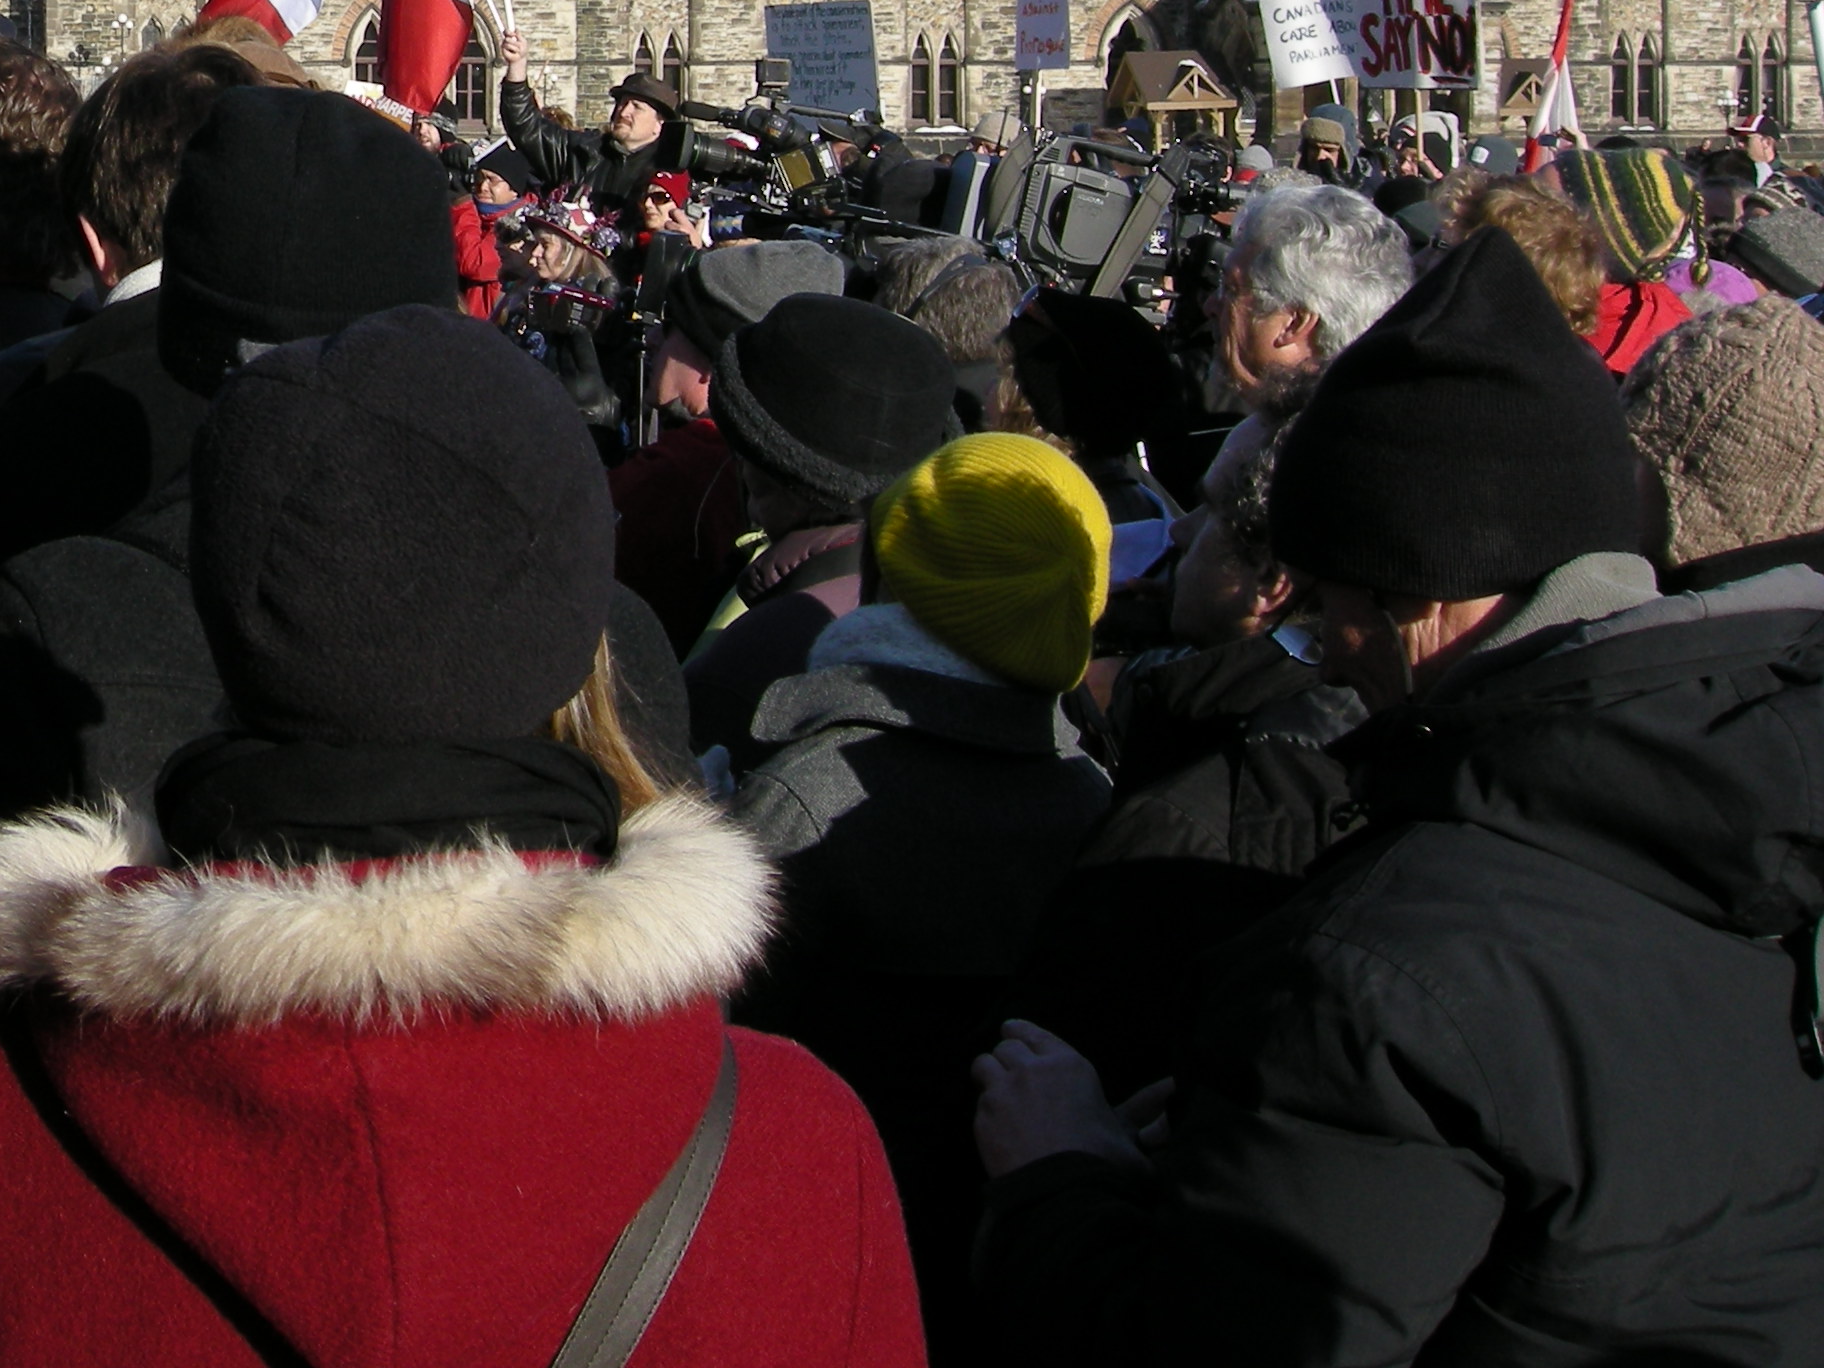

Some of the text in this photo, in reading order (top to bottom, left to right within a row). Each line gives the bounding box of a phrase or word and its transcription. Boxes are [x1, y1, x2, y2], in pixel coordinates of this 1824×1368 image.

[1273, 0, 1353, 24] CANADIANS
[1280, 19, 1357, 43] CARE ABOU
[1360, 5, 1476, 78] SAY NO!
[1289, 42, 1359, 64] PARLIAMEN
[376, 95, 415, 126] HARPE
